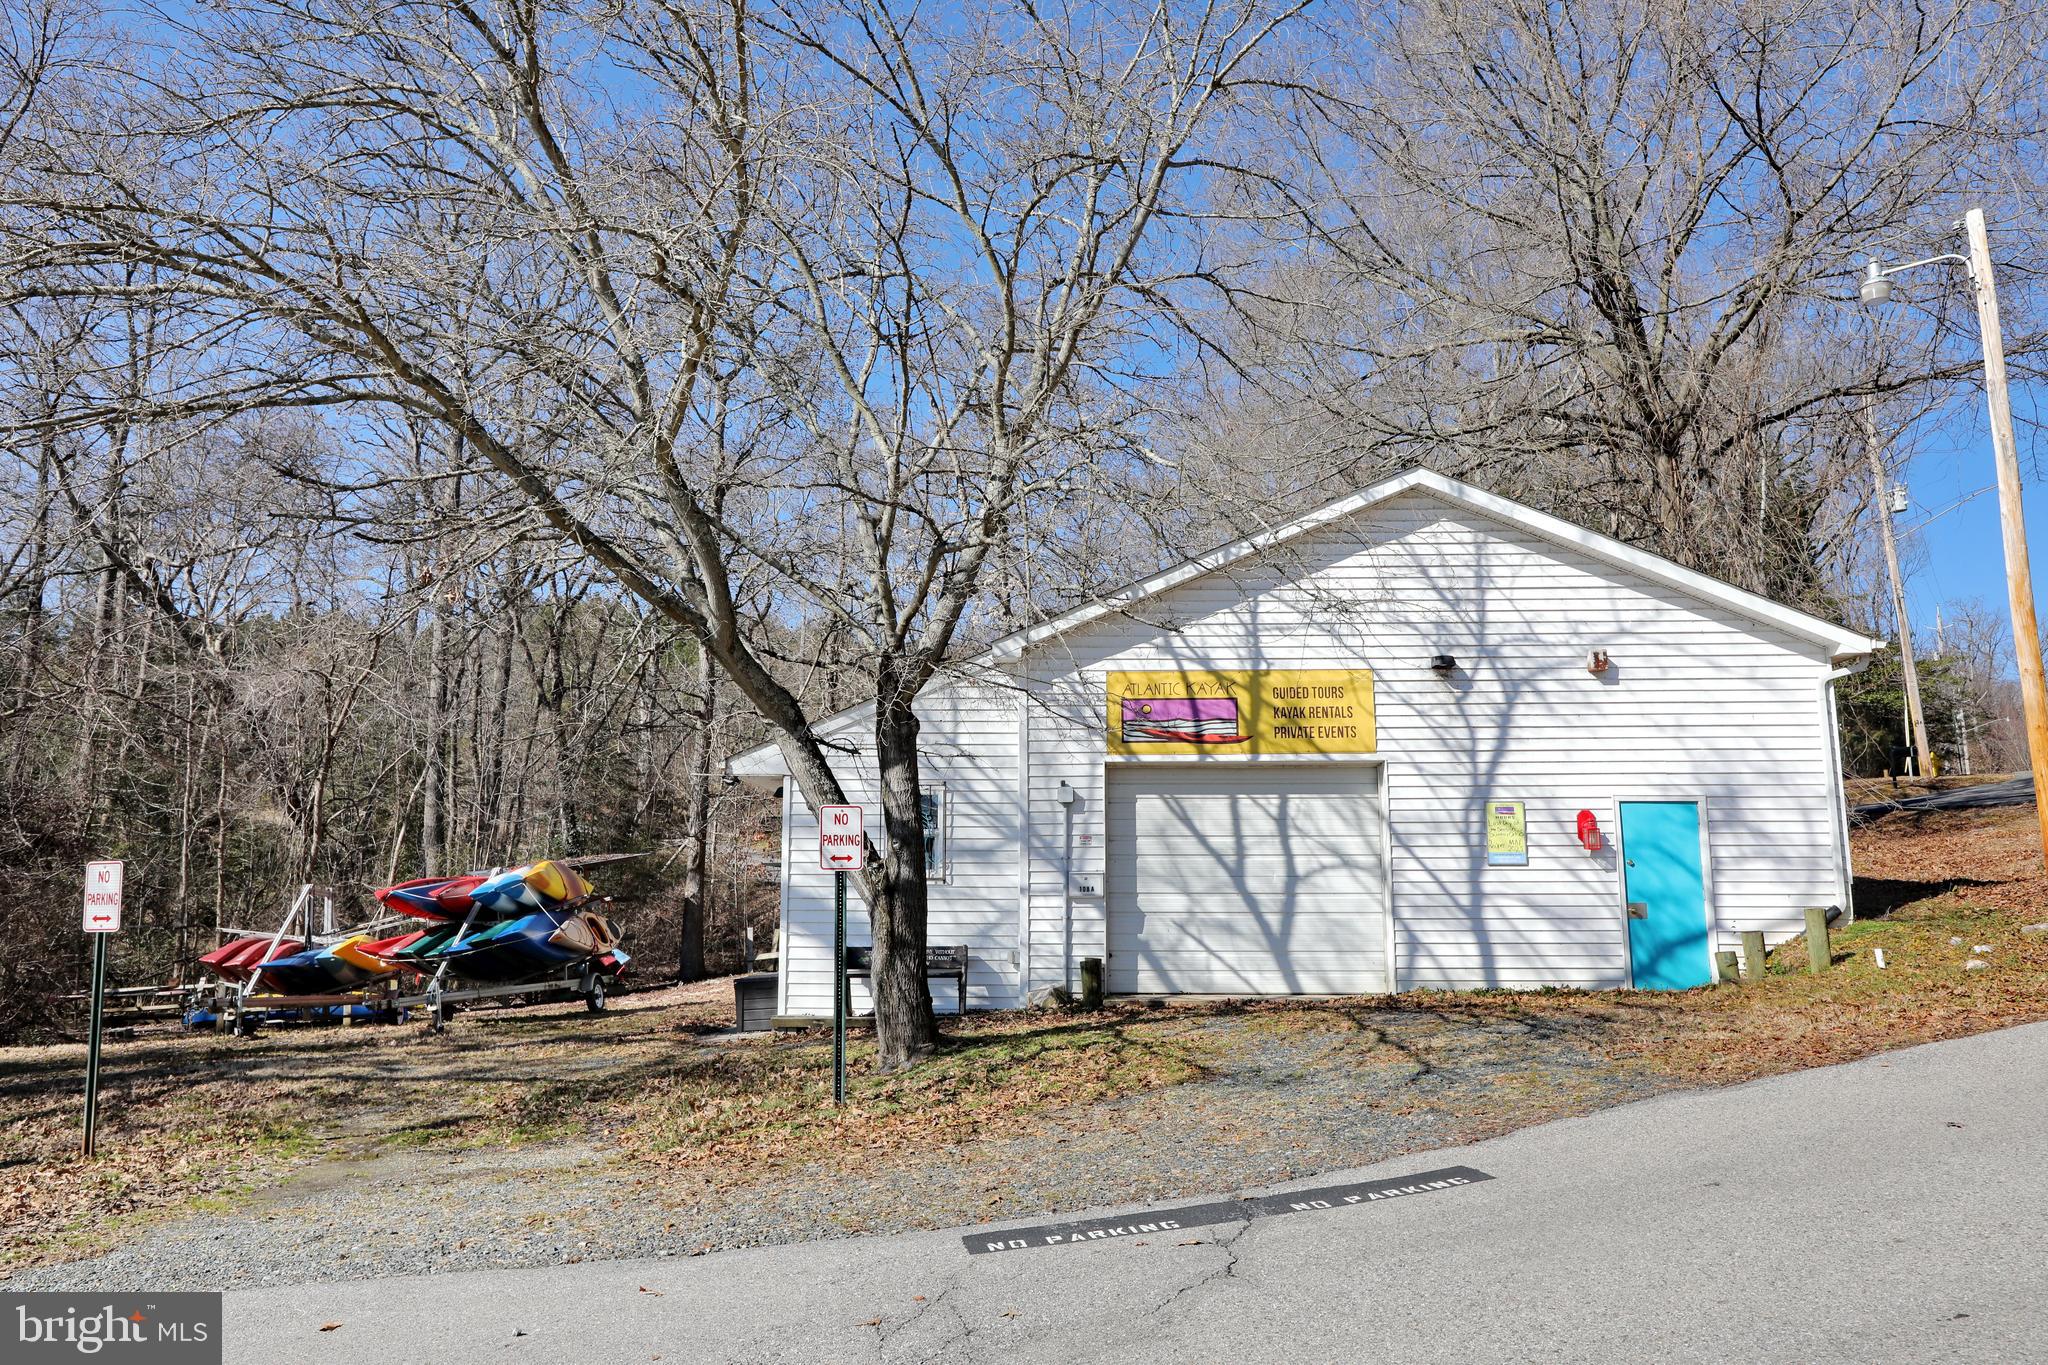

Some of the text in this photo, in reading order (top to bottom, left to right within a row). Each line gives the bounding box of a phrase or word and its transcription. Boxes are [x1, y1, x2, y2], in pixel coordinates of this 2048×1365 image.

[1122, 682, 1237, 696] ATLANTIC KAYAK
[1273, 686, 1344, 699] GUIDED TOURS
[1273, 706, 1353, 719] KAYAK RENTALS
[1274, 726, 1357, 739] PRIVATE EVENTS
[834, 813, 849, 826] NO
[822, 834, 861, 847] PARKING
[98, 870, 111, 883] NO
[87, 892, 119, 906] PARKING
[1288, 1177, 1471, 1212] NO PARKING
[986, 1220, 1180, 1252] NO PARKING
